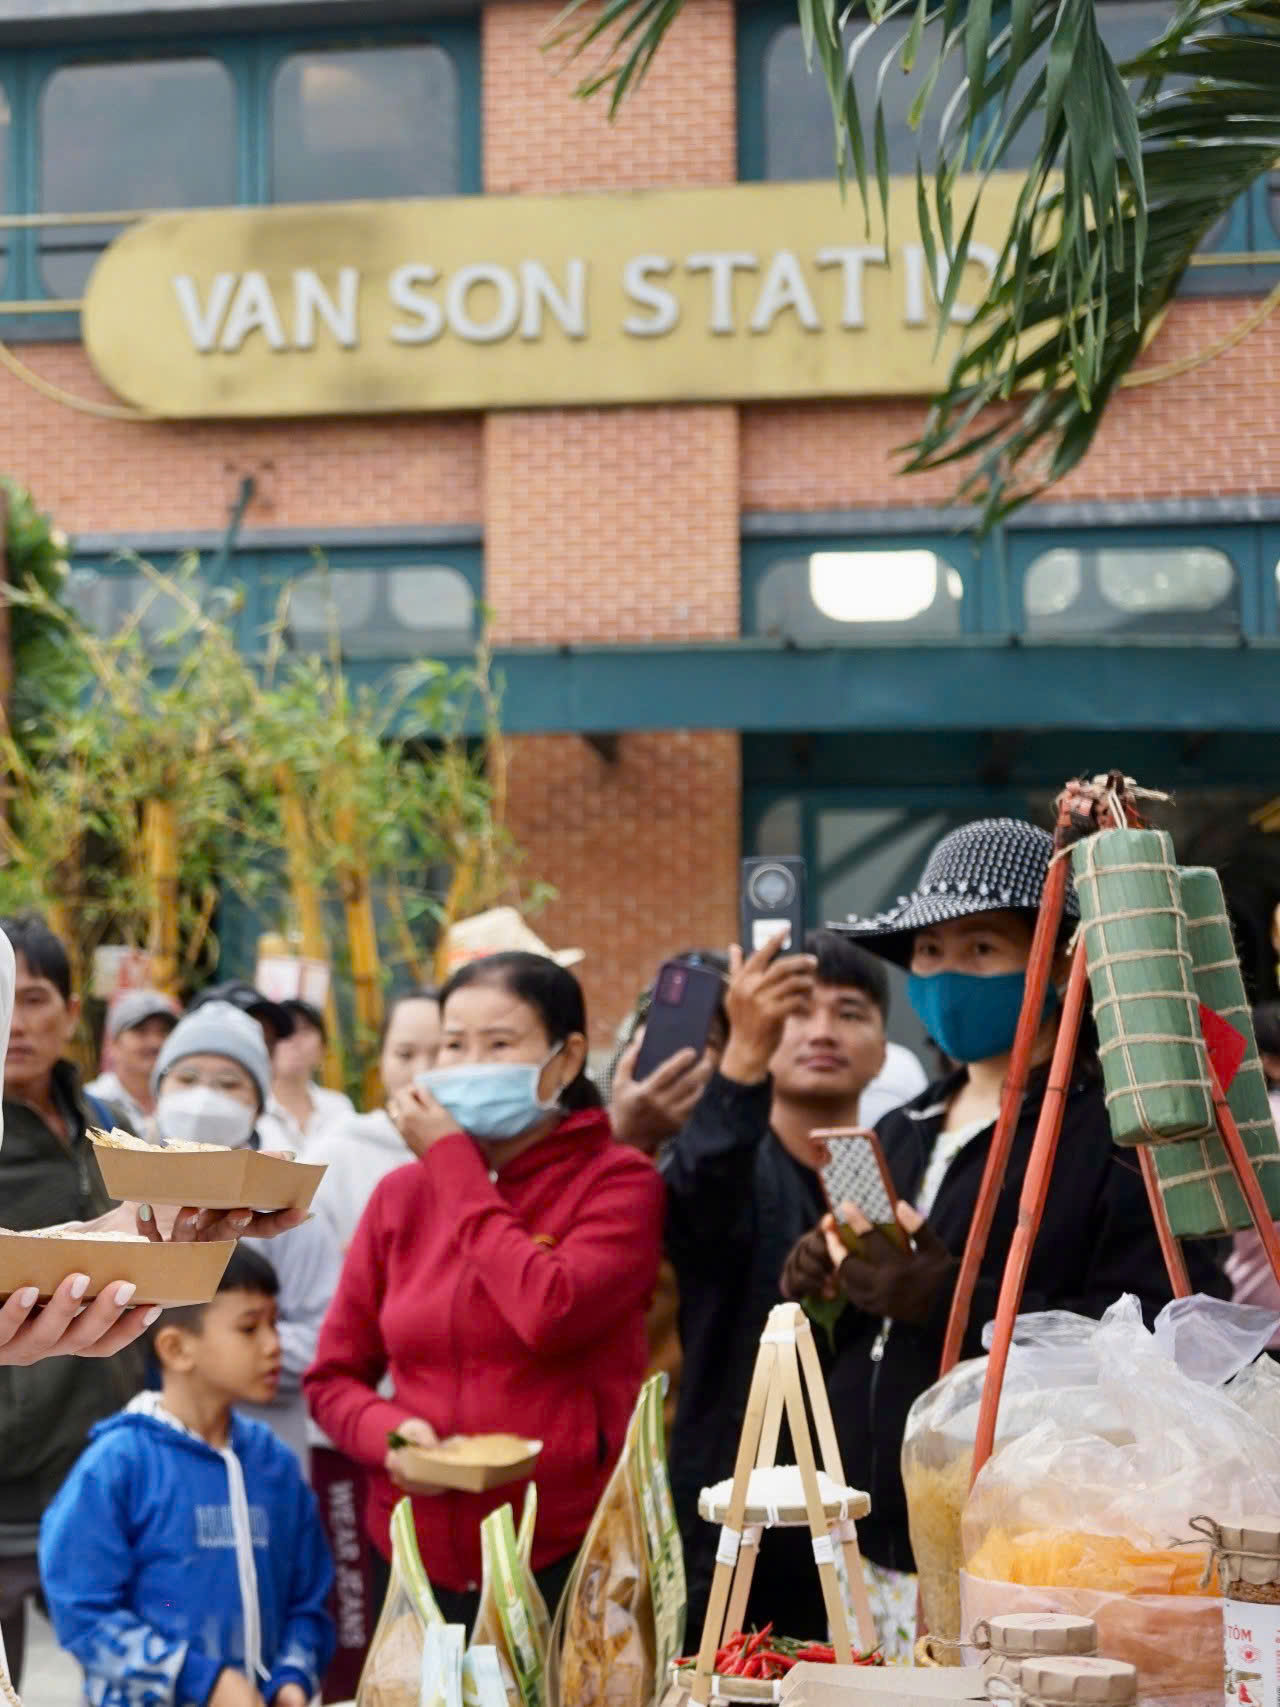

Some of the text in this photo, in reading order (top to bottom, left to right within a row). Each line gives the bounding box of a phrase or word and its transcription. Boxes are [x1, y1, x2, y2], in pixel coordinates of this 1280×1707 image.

[173, 242, 1016, 351] VAN SON STATIO
